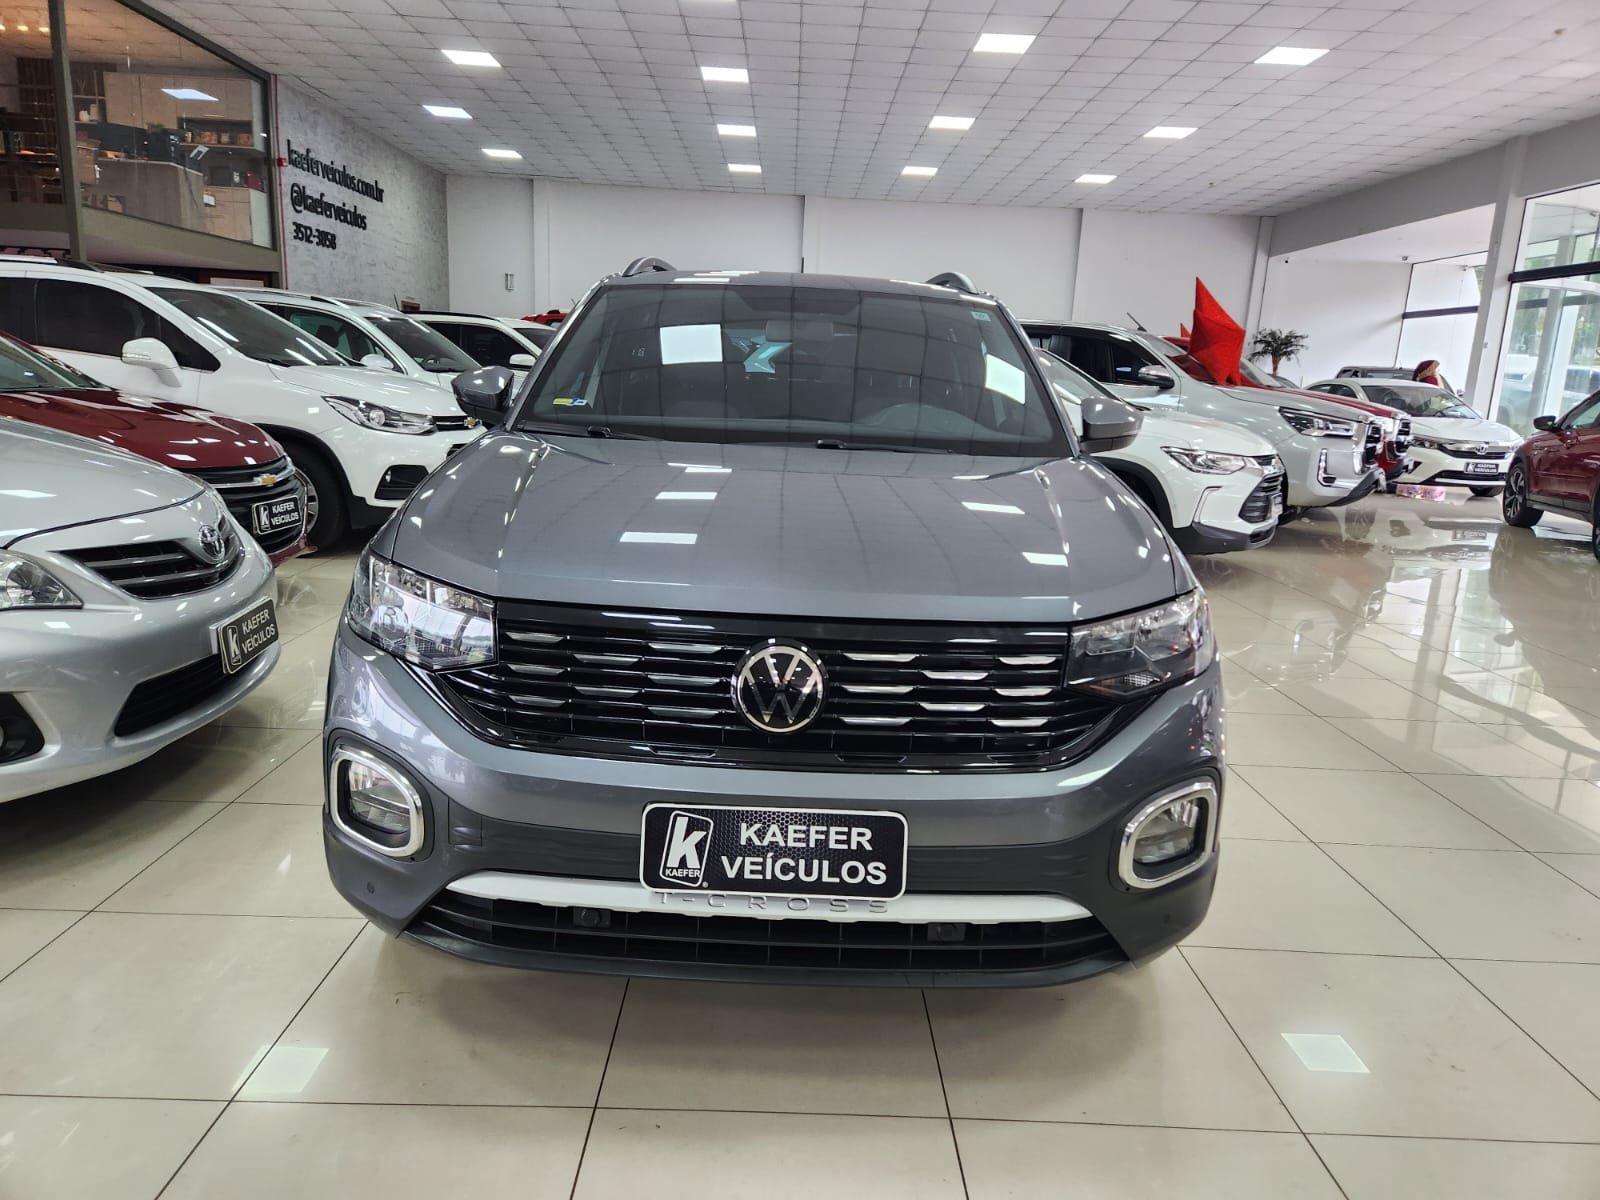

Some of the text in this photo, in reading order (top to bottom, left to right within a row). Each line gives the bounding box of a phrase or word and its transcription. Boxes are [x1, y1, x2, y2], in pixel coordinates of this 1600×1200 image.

[287, 139, 384, 203] kaeferveiculos.com.br
[290, 183, 367, 230] @kaeferveiculos
[272, 502, 295, 514] KAEFER
[242, 609, 270, 635] KAEFER
[242, 624, 276, 654] VEÍCULOS
[740, 823, 873, 850] KAEFER
[665, 868, 701, 878] KAEFER
[721, 853, 887, 885] VEÍCULOS
